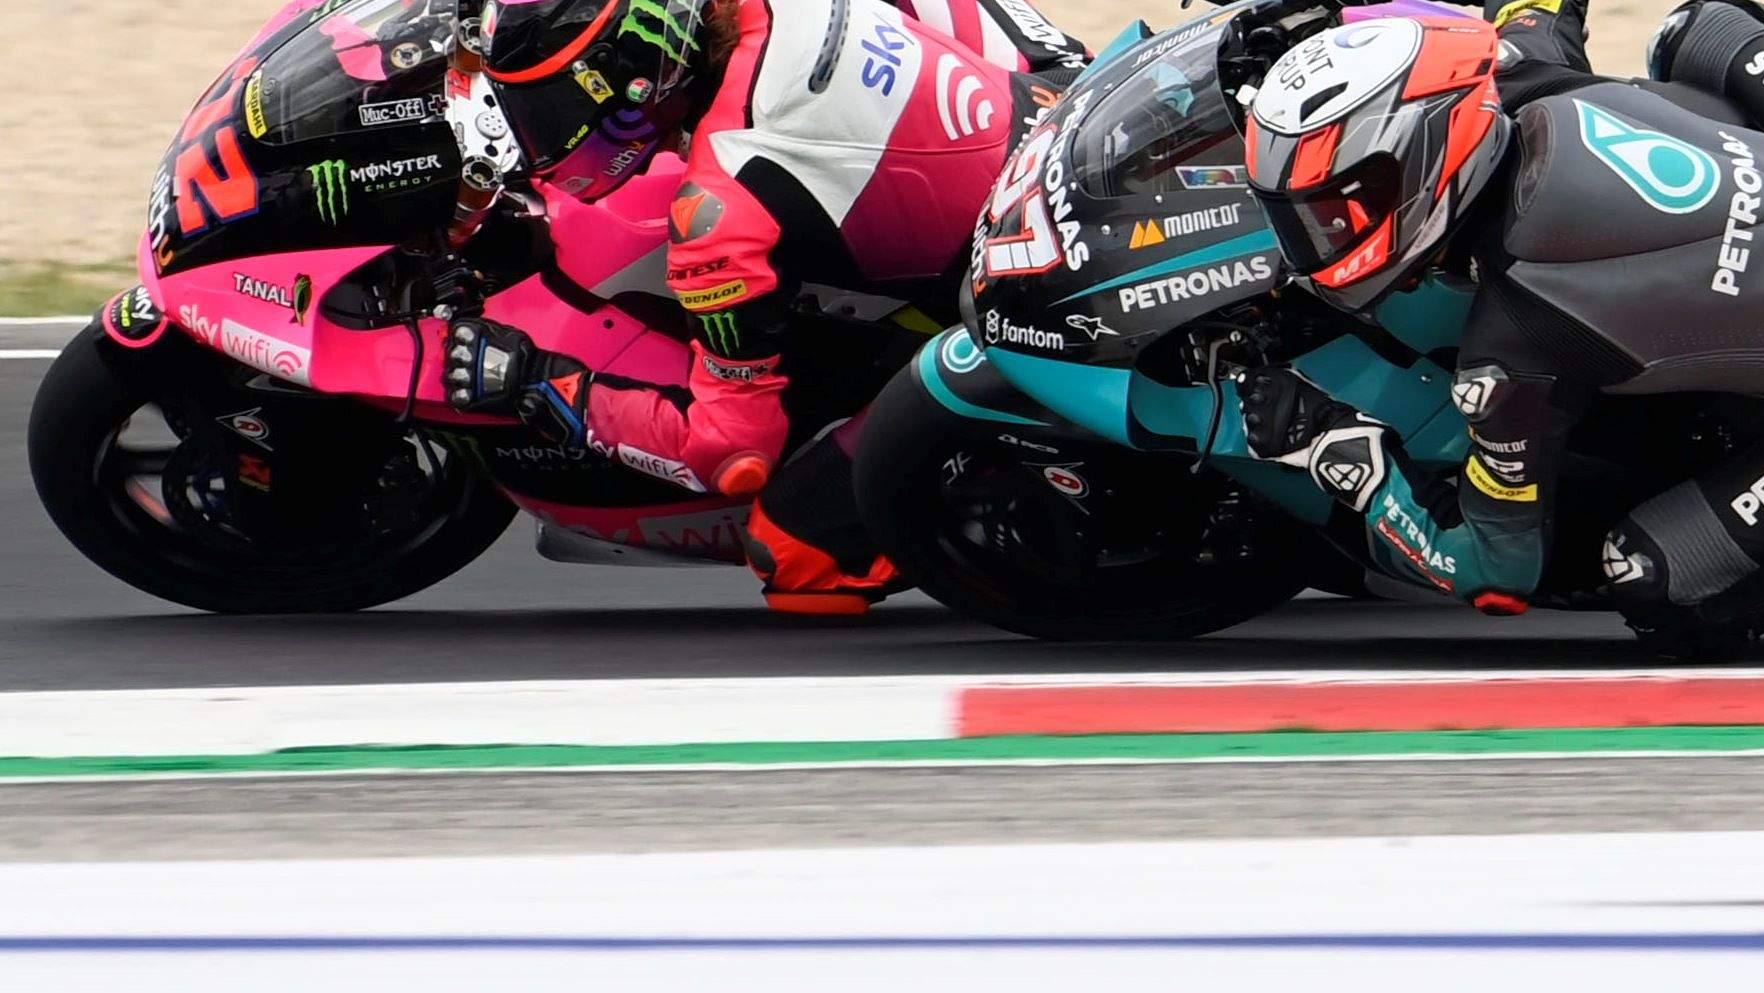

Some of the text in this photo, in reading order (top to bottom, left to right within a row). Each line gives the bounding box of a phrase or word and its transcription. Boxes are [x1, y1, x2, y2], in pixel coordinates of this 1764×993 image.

[1302, 37, 1334, 75] ONT
[361, 101, 423, 124] Muc-Off
[364, 175, 433, 193] ENERGY
[1163, 202, 1242, 239] monitor
[1333, 237, 1379, 283] MT
[232, 272, 291, 309] TANAL
[684, 283, 743, 305] DUNLOP
[1118, 255, 1273, 313] PETRONAS
[179, 303, 271, 370] sky wifi
[1002, 317, 1064, 351] fantom
[623, 451, 671, 479] wifi
